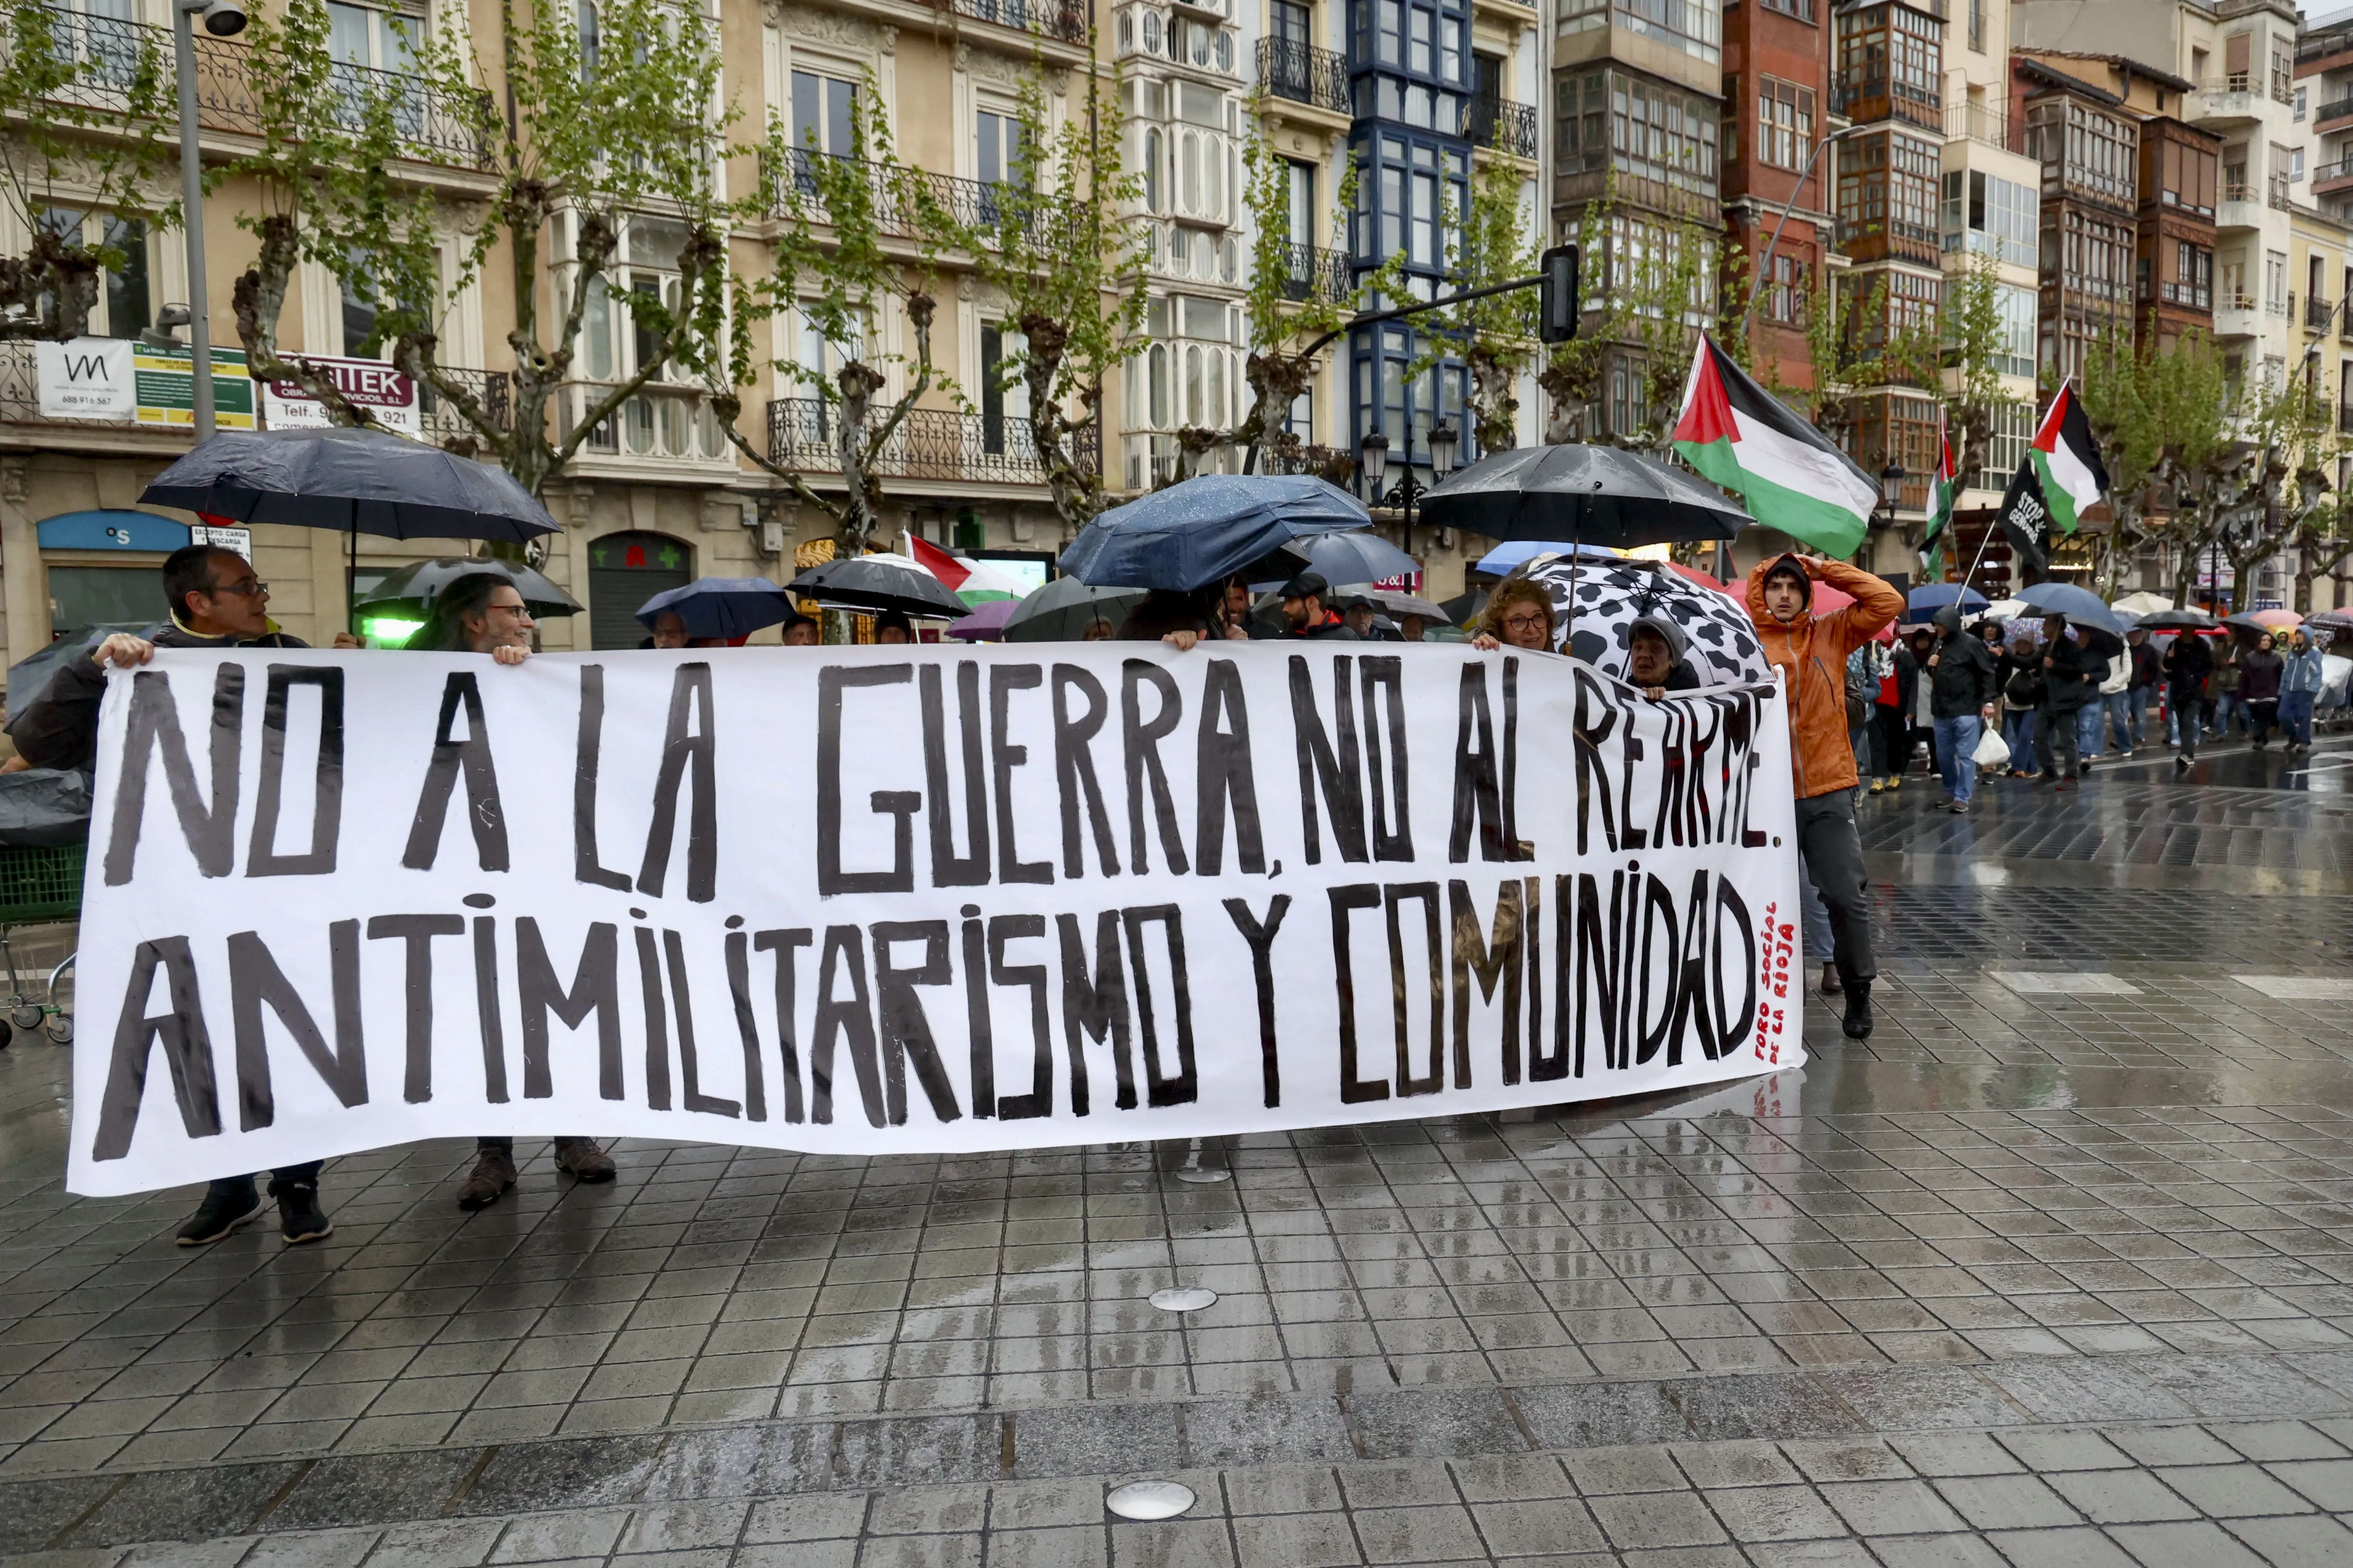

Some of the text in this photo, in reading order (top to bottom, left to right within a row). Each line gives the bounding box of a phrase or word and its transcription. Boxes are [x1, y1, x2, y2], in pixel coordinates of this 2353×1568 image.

[282, 404, 312, 417] Telf.
[383, 411, 406, 424] 921
[2018, 491, 2045, 523] STOP
[103, 661, 344, 886] NO
[399, 671, 510, 873] A
[574, 661, 717, 904] LA
[817, 658, 1282, 901] GUERRA,
[1288, 654, 1416, 866] NO
[1448, 656, 1535, 864] AL
[1221, 893, 1292, 1109] Y
[1755, 1002, 1770, 1061] FORO
[1772, 1009, 1784, 1035] LA
[1770, 1042, 1779, 1065] DE
